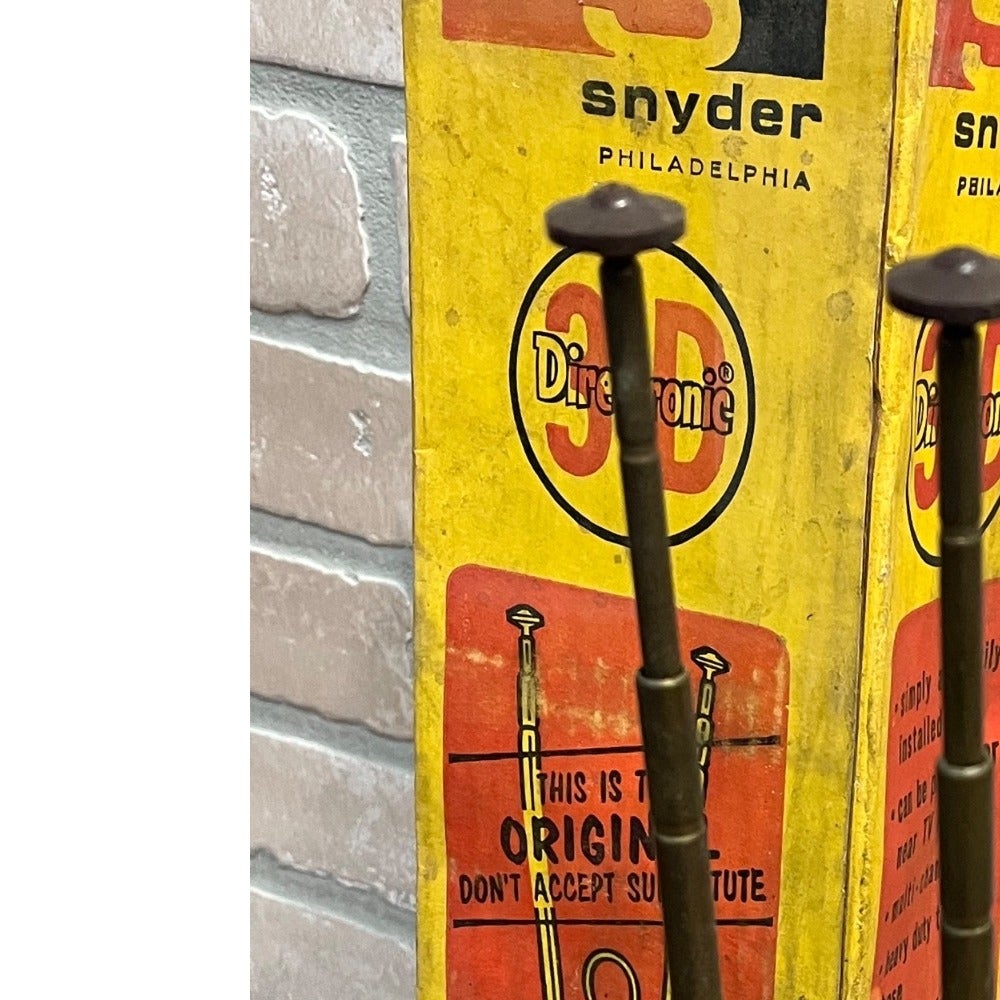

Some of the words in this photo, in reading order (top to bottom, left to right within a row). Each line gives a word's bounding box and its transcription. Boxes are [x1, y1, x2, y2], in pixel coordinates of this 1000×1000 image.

[581, 79, 823, 139] snyder
[599, 146, 811, 192] PHILADELPHIA
[536, 770, 588, 805] THIS
[600, 769, 622, 804] IS
[500, 813, 721, 866] ORIGIN
[459, 873, 521, 905] DON'T
[534, 872, 615, 905] ACCEPT
[627, 867, 767, 905] SUTUTE
